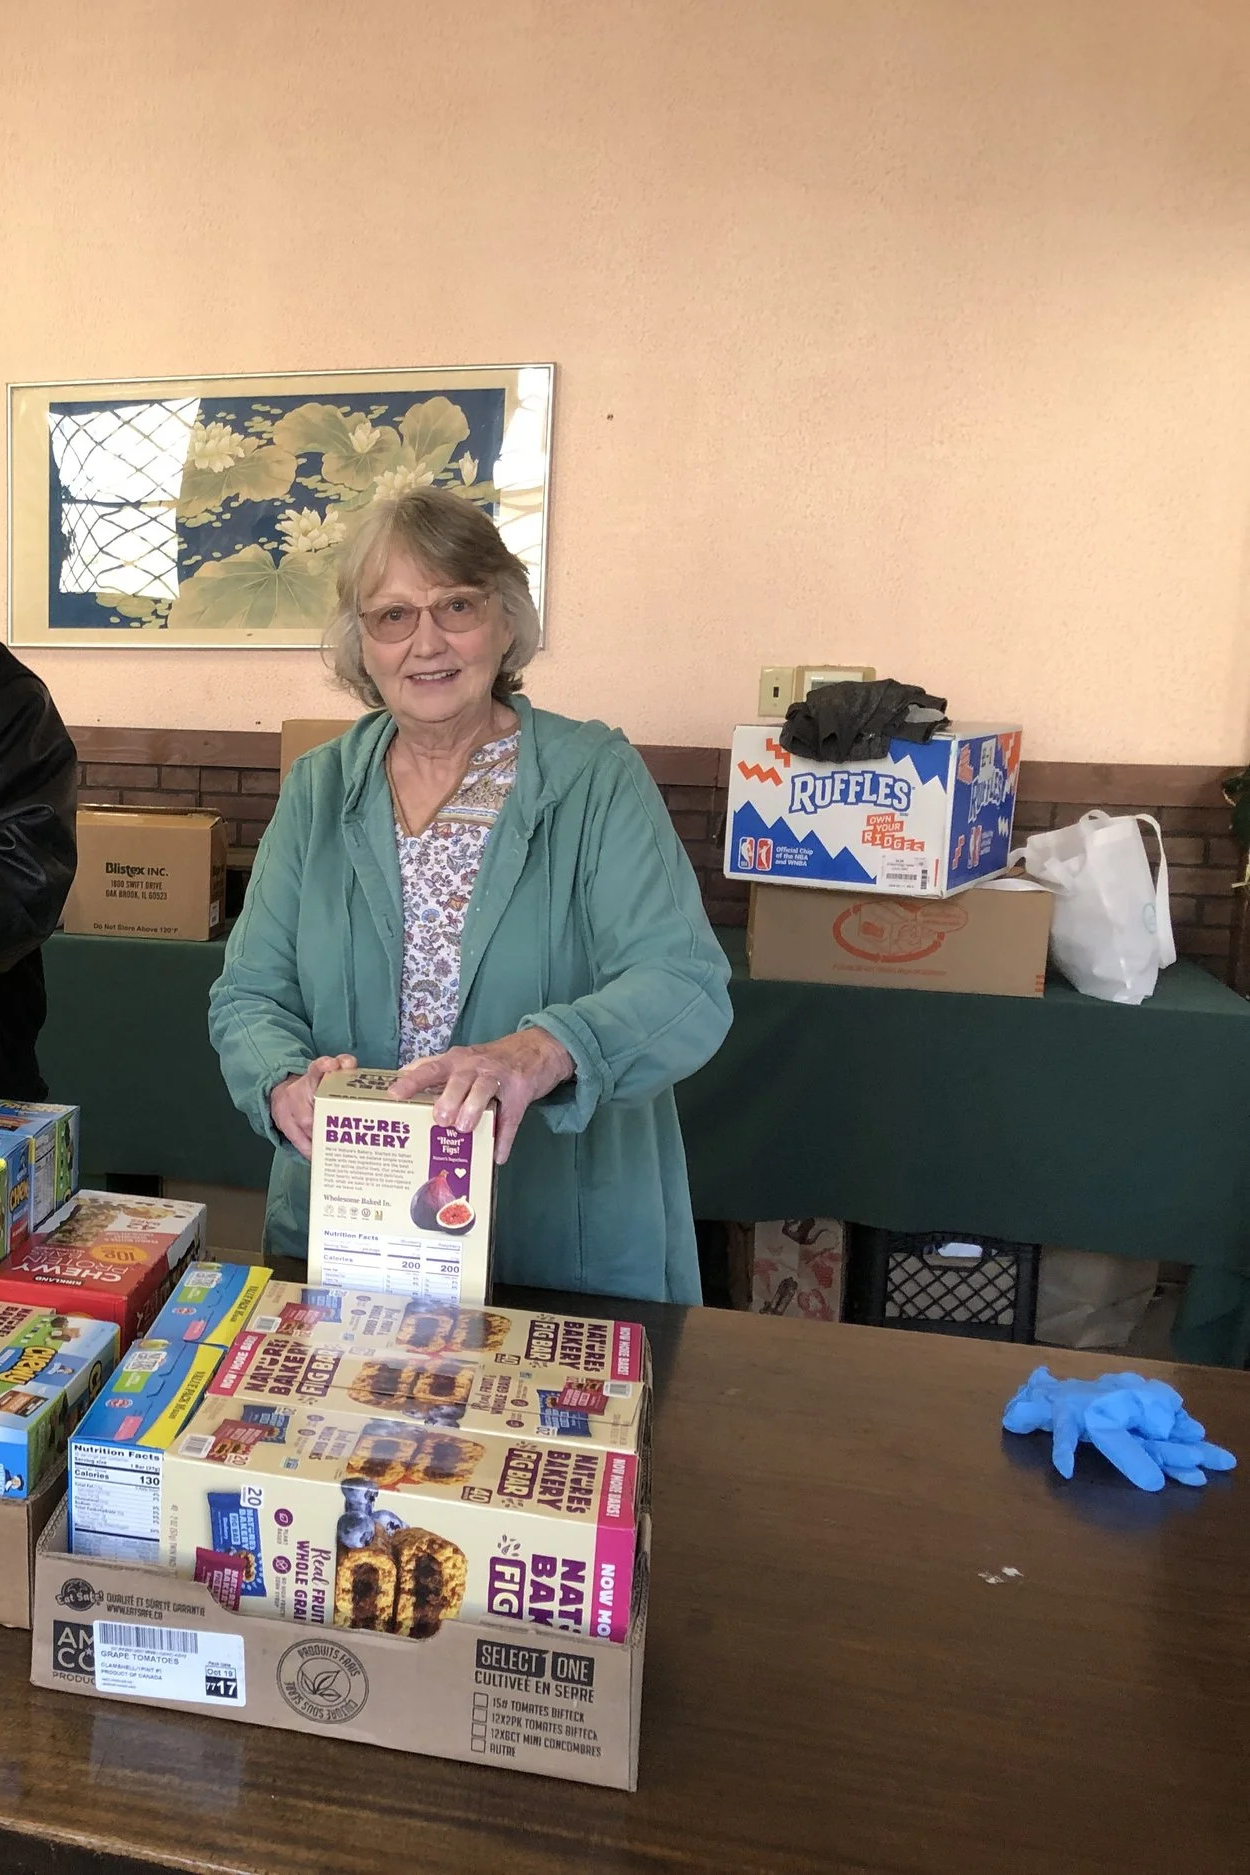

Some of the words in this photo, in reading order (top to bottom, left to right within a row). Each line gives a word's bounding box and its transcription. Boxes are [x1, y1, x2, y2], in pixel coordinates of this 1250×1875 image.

[869, 815, 892, 825] OWN
[875, 822, 901, 832] YOUR
[775, 846, 799, 854] Official
[799, 847, 814, 856] Chip
[864, 831, 924, 852] RIDGES
[105, 862, 145, 878] Blistex
[147, 867, 169, 877] INC.
[111, 879, 125, 888] 1800
[125, 880, 144, 889] SWIFT
[144, 881, 162, 890] DRIVE
[105, 889, 117, 898] OAK
[118, 890, 140, 900] BROOK,
[141, 891, 148, 899] IL
[148, 891, 168, 901] 60523
[93, 922, 103, 930] Do
[325, 1129, 410, 1150] BAKERY
[445, 1128, 458, 1138] We
[442, 1145, 460, 1156] Figs!
[323, 1193, 360, 1204] Wholesome
[361, 1197, 382, 1206] Baked
[324, 1229, 357, 1239] Nutrition
[358, 1233, 379, 1241] Facts
[23, 1254, 130, 1275] PROTEIN
[323, 1254, 354, 1263] Calories
[401, 1261, 421, 1270] 200
[11, 1263, 122, 1282] CHEWY
[440, 1264, 460, 1273] 200
[35, 1276, 82, 1286] KIRKLAND
[533, 1322, 556, 1340] FIG
[530, 1339, 554, 1361] BAR
[559, 1321, 585, 1371] BAKERY
[220, 1370, 238, 1389] NOW
[233, 1349, 249, 1371] MORE
[268, 1340, 312, 1396] BAKERY
[298, 1369, 329, 1394] FIG
[74, 1444, 125, 1457] Nutrition
[128, 1451, 160, 1462] Facts
[508, 1450, 538, 1473] FIG
[612, 1458, 626, 1474] NOW
[74, 1469, 110, 1480] Calories
[140, 1475, 160, 1486] 130
[503, 1472, 534, 1498] BAR
[537, 1449, 572, 1512] BAKERY
[608, 1474, 624, 1493] MORE
[247, 1486, 263, 1508] 20
[605, 1493, 621, 1518] BARS!
[230, 1515, 239, 1528] FIG
[239, 1508, 249, 1550] BAKERY
[231, 1527, 239, 1543] BAR
[295, 1540, 310, 1586] WHOLE
[310, 1548, 332, 1587] Real
[492, 1564, 521, 1619] FIG
[599, 1563, 616, 1607] NOW
[106, 1591, 135, 1605] QUALITÉ
[135, 1596, 145, 1607] ET
[172, 1601, 206, 1618] GARANTIE
[311, 1588, 326, 1624] FRUIT
[101, 1650, 130, 1661] GRAPE
[132, 1653, 180, 1665] TOMATOES
[297, 1644, 340, 1660] PRODUITS
[338, 1652, 361, 1677] FRAIS
[481, 1644, 539, 1673] SELECT
[556, 1657, 590, 1682] ONE
[101, 1669, 129, 1677] PRODUCT
[138, 1673, 163, 1681] CANADA
[207, 1668, 222, 1676] Oct
[284, 1680, 304, 1706] SERRE
[535, 1681, 550, 1696] EN
[300, 1700, 324, 1720] SOUS
[492, 1697, 508, 1709] 15#
[511, 1700, 549, 1717] TOMATES
[551, 1709, 585, 1723] BIFTECK
[491, 1712, 523, 1728] 12X2PK
[525, 1718, 563, 1736] TOMATES
[565, 1725, 599, 1742] BIFTECK
[489, 1743, 516, 1758] AUTRE
[522, 1733, 542, 1747] MINI
[543, 1736, 601, 1758] CONCOMBRES
